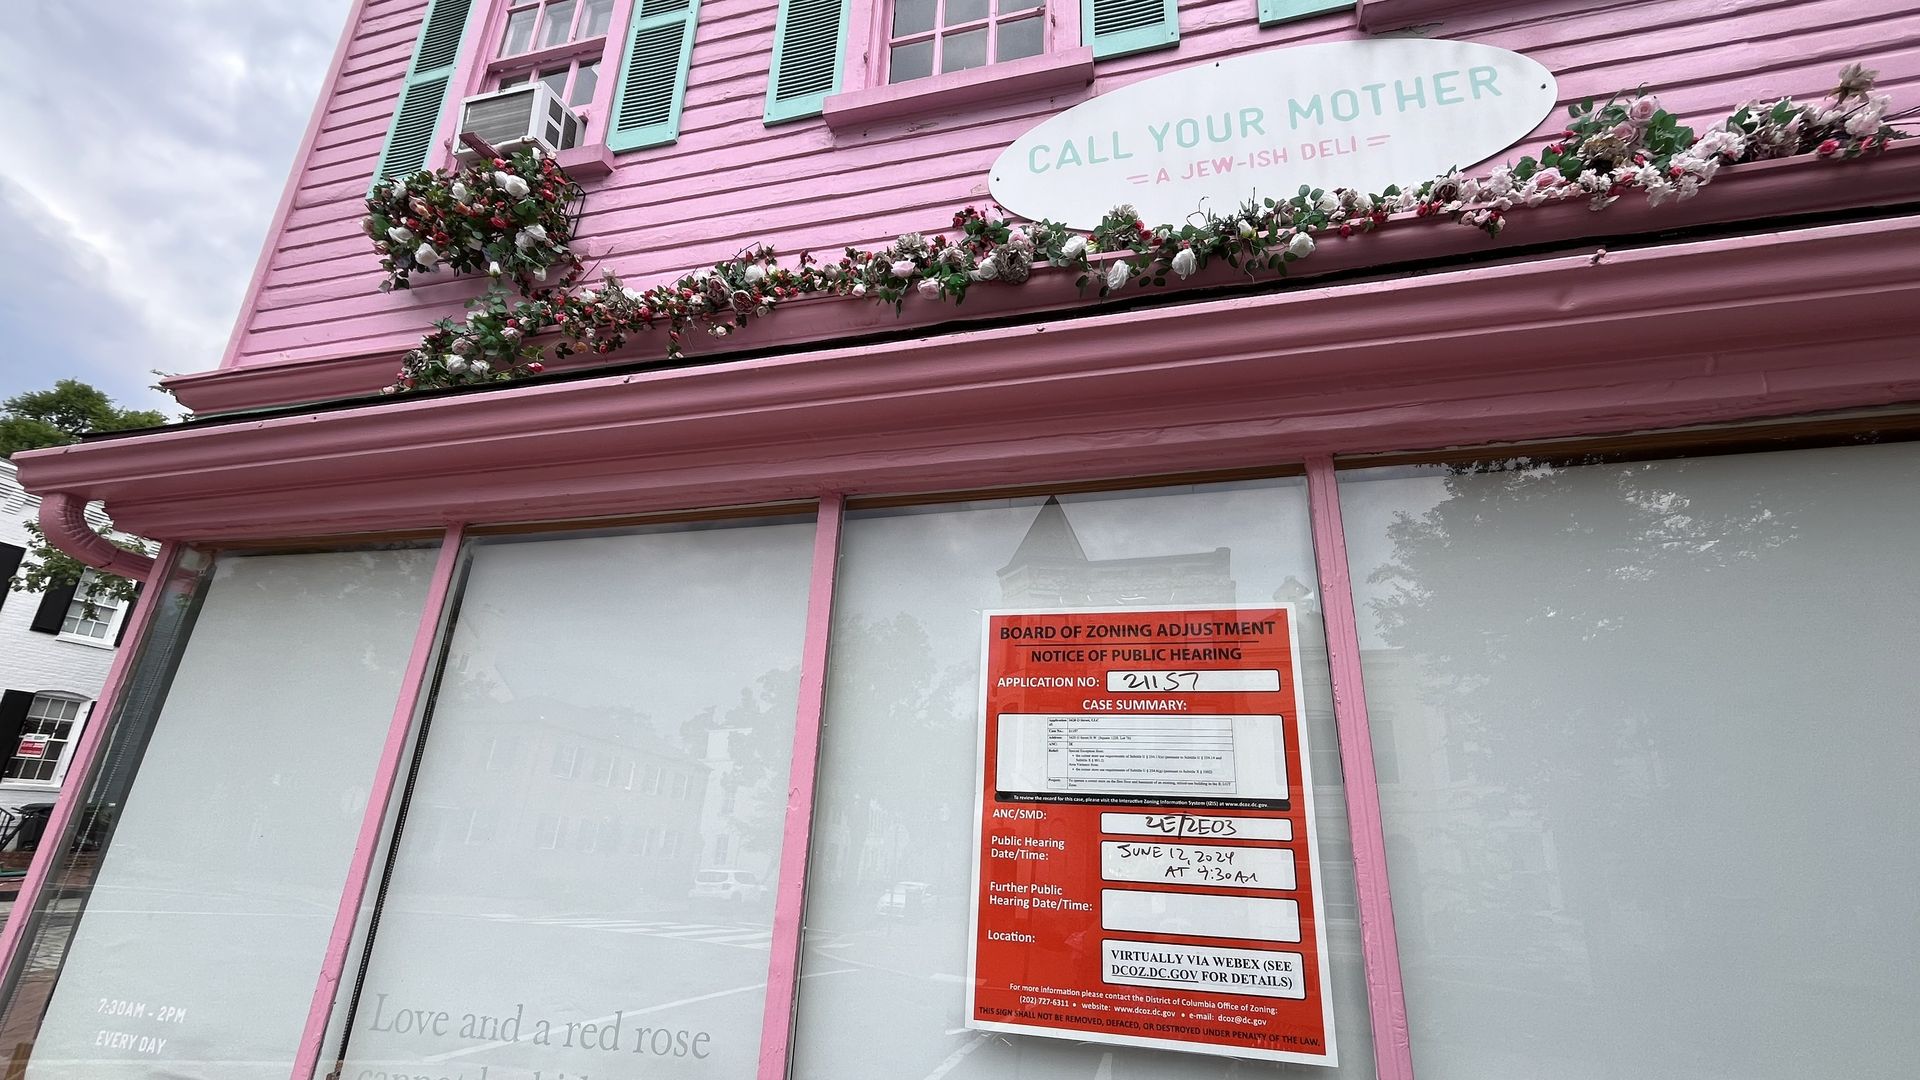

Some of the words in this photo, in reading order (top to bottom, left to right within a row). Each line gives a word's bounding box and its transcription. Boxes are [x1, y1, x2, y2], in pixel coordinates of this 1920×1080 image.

[1028, 131, 1133, 174] CALL
[1148, 107, 1266, 152] YOUR
[1288, 65, 1503, 130] MOTHER
[1156, 167, 1171, 185] A
[1180, 148, 1289, 180] JEW-ISH
[1301, 135, 1357, 161] DELI
[1000, 626, 1056, 640] BOARD
[1060, 626, 1082, 638] OF
[1087, 623, 1152, 638] ZONING
[1156, 621, 1276, 637] ADJUSTMENT
[1031, 649, 1084, 663] NOTICE
[1087, 649, 1108, 662] OF
[1111, 648, 1166, 661] PUBLIC
[1170, 647, 1242, 661] HEARING
[997, 676, 1077, 688] APPLICATION
[1079, 676, 1100, 687] NO:
[1123, 672, 1199, 691] 21157
[1082, 699, 1113, 710] CASE
[1116, 699, 1187, 711] SUMMARY:
[992, 808, 1047, 820] ANC/SMD:
[991, 835, 1022, 846] Public
[1024, 837, 1065, 850] Hearing
[991, 848, 1049, 860] Date/Time:
[1117, 844, 1163, 859] JUNE
[1170, 848, 1191, 866] 12,
[1194, 850, 1235, 865] 2024
[1164, 865, 1190, 878] AT
[990, 881, 1028, 893] Further
[1031, 884, 1062, 895] Public
[989, 894, 1029, 909] Hearing
[1032, 897, 1093, 911] Date/Time:
[987, 929, 1036, 943] Location:
[1111, 949, 1184, 965] VIRTUALLY
[1186, 955, 1210, 966] VIA
[1212, 956, 1260, 970] WEBEX
[1263, 960, 1293, 973] (SEE
[1111, 964, 1199, 981] DCOZ.DC.GOV
[1201, 971, 1228, 983] FOR
[1231, 974, 1293, 989] DETAILS)
[1009, 983, 1020, 991] For
[1021, 985, 1040, 993] more
[1040, 985, 1080, 996] information
[1081, 990, 1104, 999] please
[1104, 992, 1130, 1001] contact
[1131, 994, 1144, 1002] the
[1145, 995, 1171, 1005] District
[1172, 997, 1180, 1005] of
[1181, 998, 1216, 1009] Columbia
[1217, 1001, 1239, 1011] Office
[1241, 1003, 1249, 1011] of
[1250, 1004, 1278, 1016] Zoning:
[97, 998, 146, 1018] 7:30AM
[157, 1005, 187, 1023] 2PM
[1019, 995, 1037, 1005] (202)
[1038, 998, 1069, 1007] 727-6311
[1081, 1003, 1111, 1012] website:
[1114, 1005, 1176, 1018] www.dcoz.dc.gov
[1189, 1012, 1214, 1021] e-mail:
[1218, 1014, 1267, 1026] dcoz@dc.gov
[368, 993, 450, 1037] Love
[459, 1004, 524, 1043] and
[532, 1019, 551, 1046] a
[562, 1011, 624, 1052] red
[633, 1026, 712, 1059] rose
[979, 1007, 995, 1015] THIS
[996, 1008, 1013, 1016] SIGN
[1014, 1010, 1035, 1019] SHALL
[1037, 1012, 1052, 1020] NOT
[1065, 1015, 1104, 1026] REMOVED,
[1106, 1019, 1141, 1030] DEFACED,
[1156, 1024, 1201, 1035] DESTROYED
[1203, 1029, 1230, 1038] UNDER
[1232, 1031, 1267, 1041] PENALTY
[1268, 1034, 1280, 1042] OF
[1300, 1037, 1320, 1046] LAW.
[95, 1030, 139, 1050] EVERY
[138, 1036, 167, 1055] DAY
